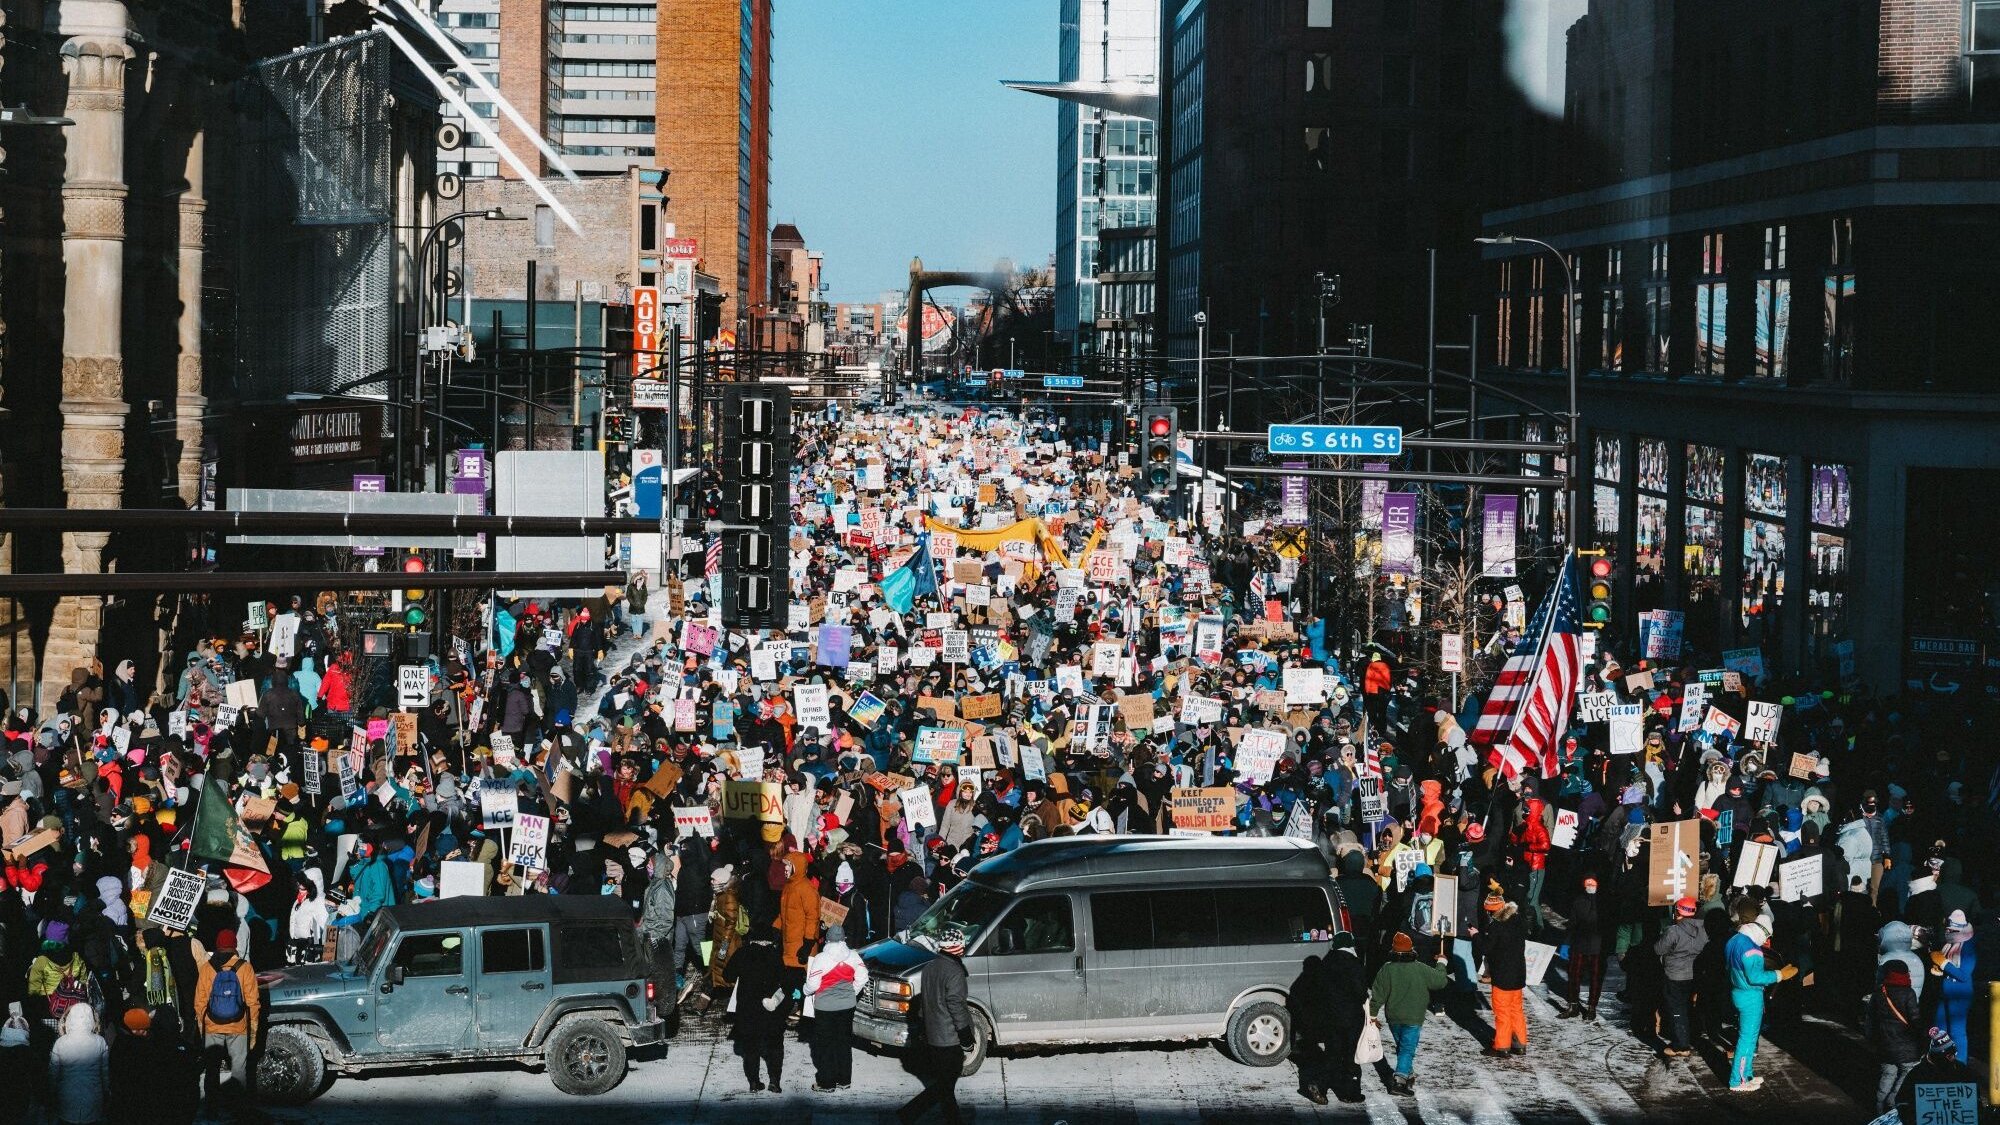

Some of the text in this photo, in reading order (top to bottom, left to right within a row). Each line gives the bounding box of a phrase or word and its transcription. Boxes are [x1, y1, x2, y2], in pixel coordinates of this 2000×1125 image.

[326, 412, 361, 438] CENTER
[1301, 431, 1396, 448] S 6th St
[862, 513, 879, 521] ICE
[863, 521, 880, 529] OUT!
[876, 528, 896, 536] ICE
[934, 538, 953, 548] ICE
[1005, 542, 1025, 554] ICE
[933, 547, 955, 557] OUT!
[1093, 556, 1114, 567] ICE
[1093, 566, 1114, 577] OUT!
[1063, 588, 1075, 596] LOVE
[972, 629, 998, 638] FUCK
[767, 642, 790, 650] FUCK
[1914, 640, 1976, 653] EMERALD BAR
[773, 651, 787, 659] CE
[667, 662, 683, 672] MN
[403, 669, 425, 679] ONE
[403, 680, 426, 690] WAY
[1200, 699, 1221, 709] HUMAN
[1583, 694, 1616, 710] FUCK
[219, 706, 237, 715] FUERA
[803, 706, 823, 714] DEFINED
[1589, 708, 1611, 722] ICE
[1611, 705, 1641, 716] ICE OUT
[1709, 708, 1737, 734] ICE
[1764, 718, 1772, 730] 4
[930, 731, 937, 739] I
[1246, 736, 1278, 752] STOP
[1181, 789, 1202, 798] KEEP
[907, 793, 928, 807] MINN
[1174, 797, 1225, 808] MINNESOTA
[490, 811, 513, 825] ICE
[519, 816, 543, 829] MN
[1174, 813, 1206, 828] ABOLISH
[516, 829, 543, 840] nice
[511, 843, 544, 860] FUCK
[1398, 852, 1422, 862] ICE
[515, 855, 536, 867] ICE
[1399, 862, 1415, 871] OU
[170, 871, 206, 884] ARREST
[169, 877, 202, 894] JONATHAN
[166, 887, 197, 903] ROSS FOR
[159, 896, 193, 916] MURDER
[152, 908, 190, 924] NOW!
[1918, 1085, 1973, 1099] DEFEND
[1928, 1099, 1962, 1110] THE
[1922, 1110, 1974, 1125] SHIRE
